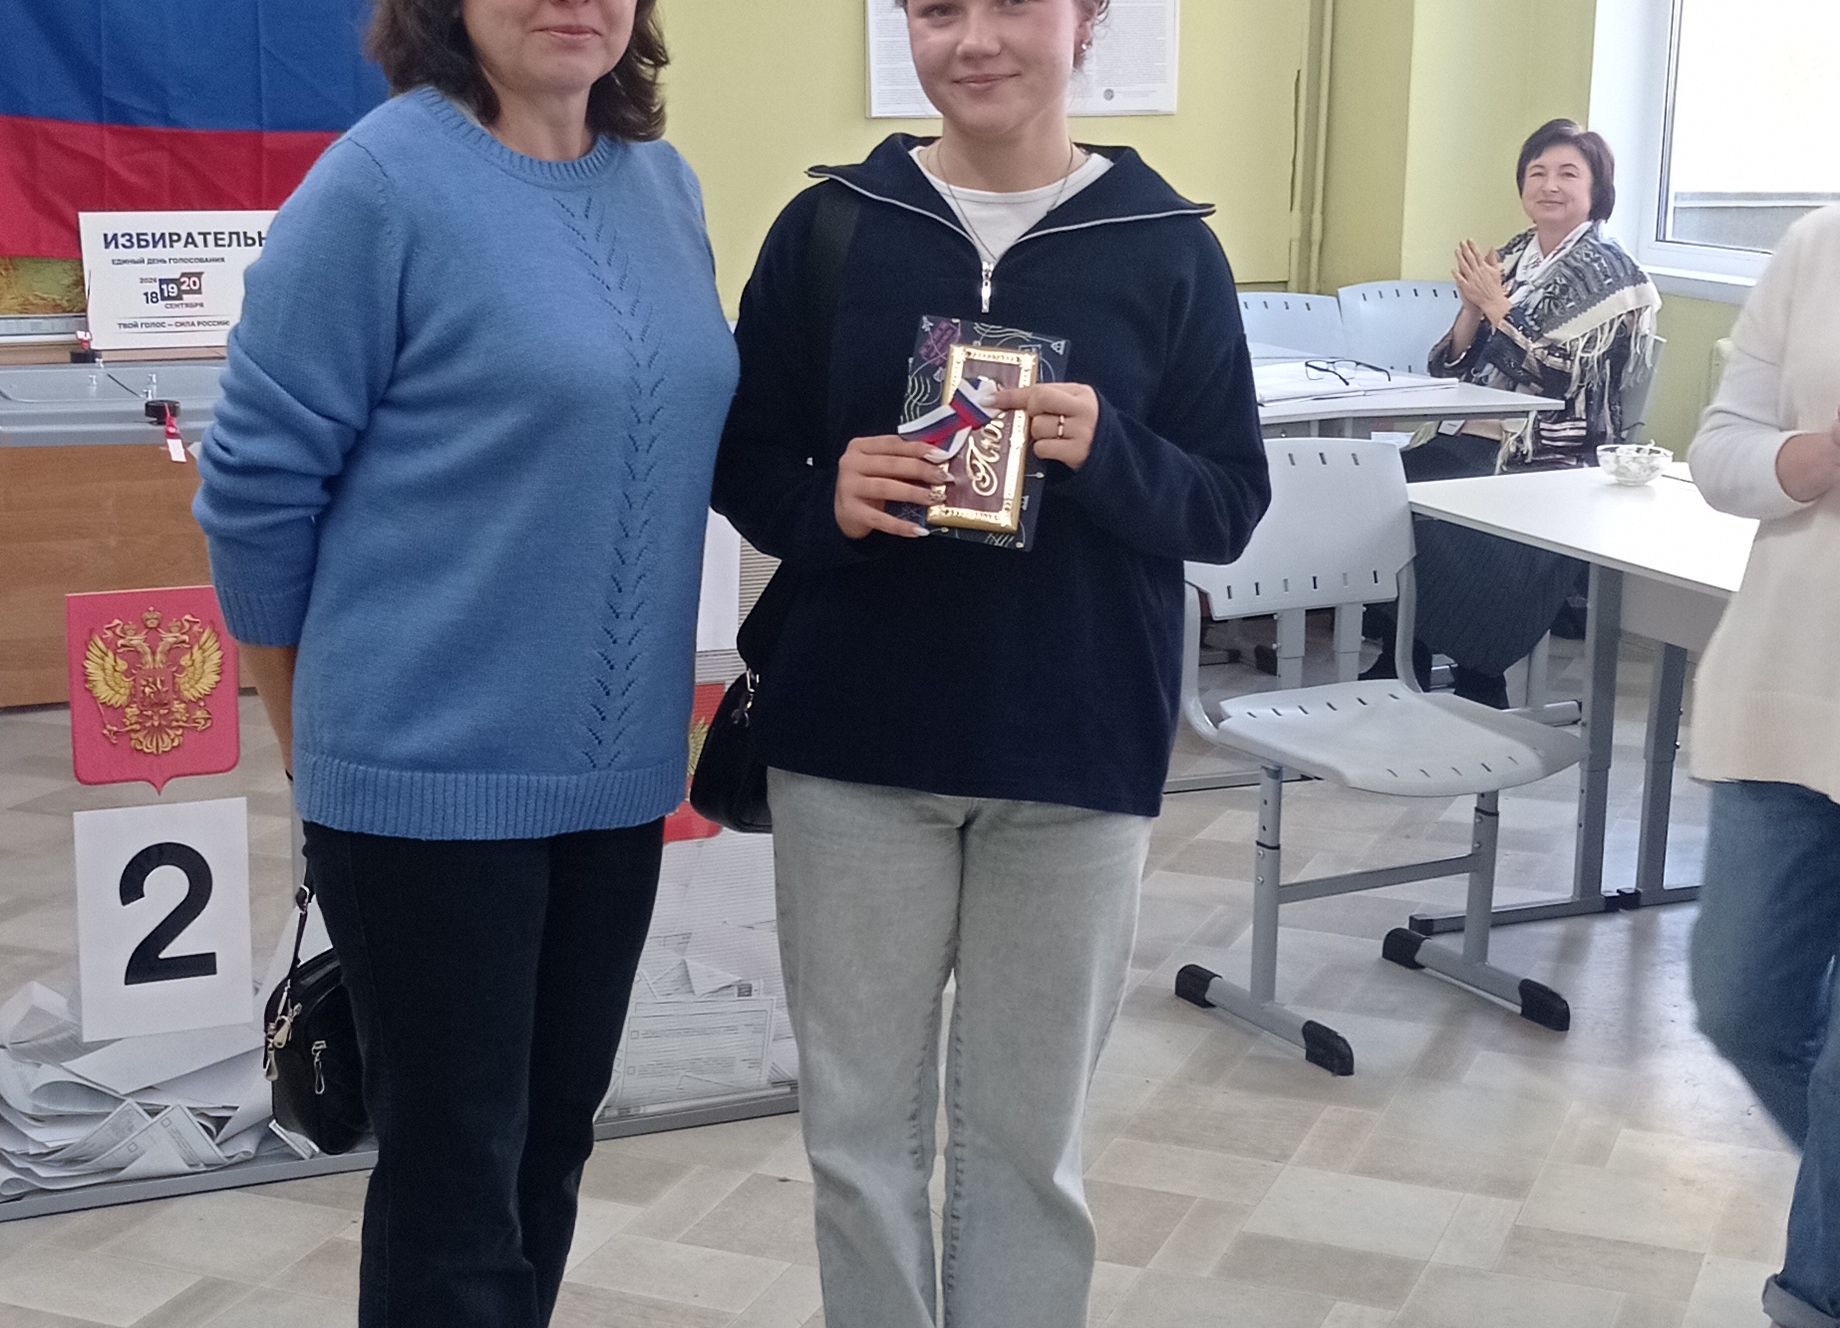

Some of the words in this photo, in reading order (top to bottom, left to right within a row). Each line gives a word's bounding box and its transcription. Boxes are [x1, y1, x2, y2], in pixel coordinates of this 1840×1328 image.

[111, 257, 145, 266] ЕДИНЫЙ
[168, 257, 225, 265] ГОЛОСОВАНИЯ
[143, 291, 159, 305] 18
[161, 283, 178, 297] 19
[179, 277, 200, 290] 20
[164, 302, 204, 310] СЕНТЯБРЯ
[117, 321, 139, 329] ТВОЙ
[117, 840, 218, 987] 2
